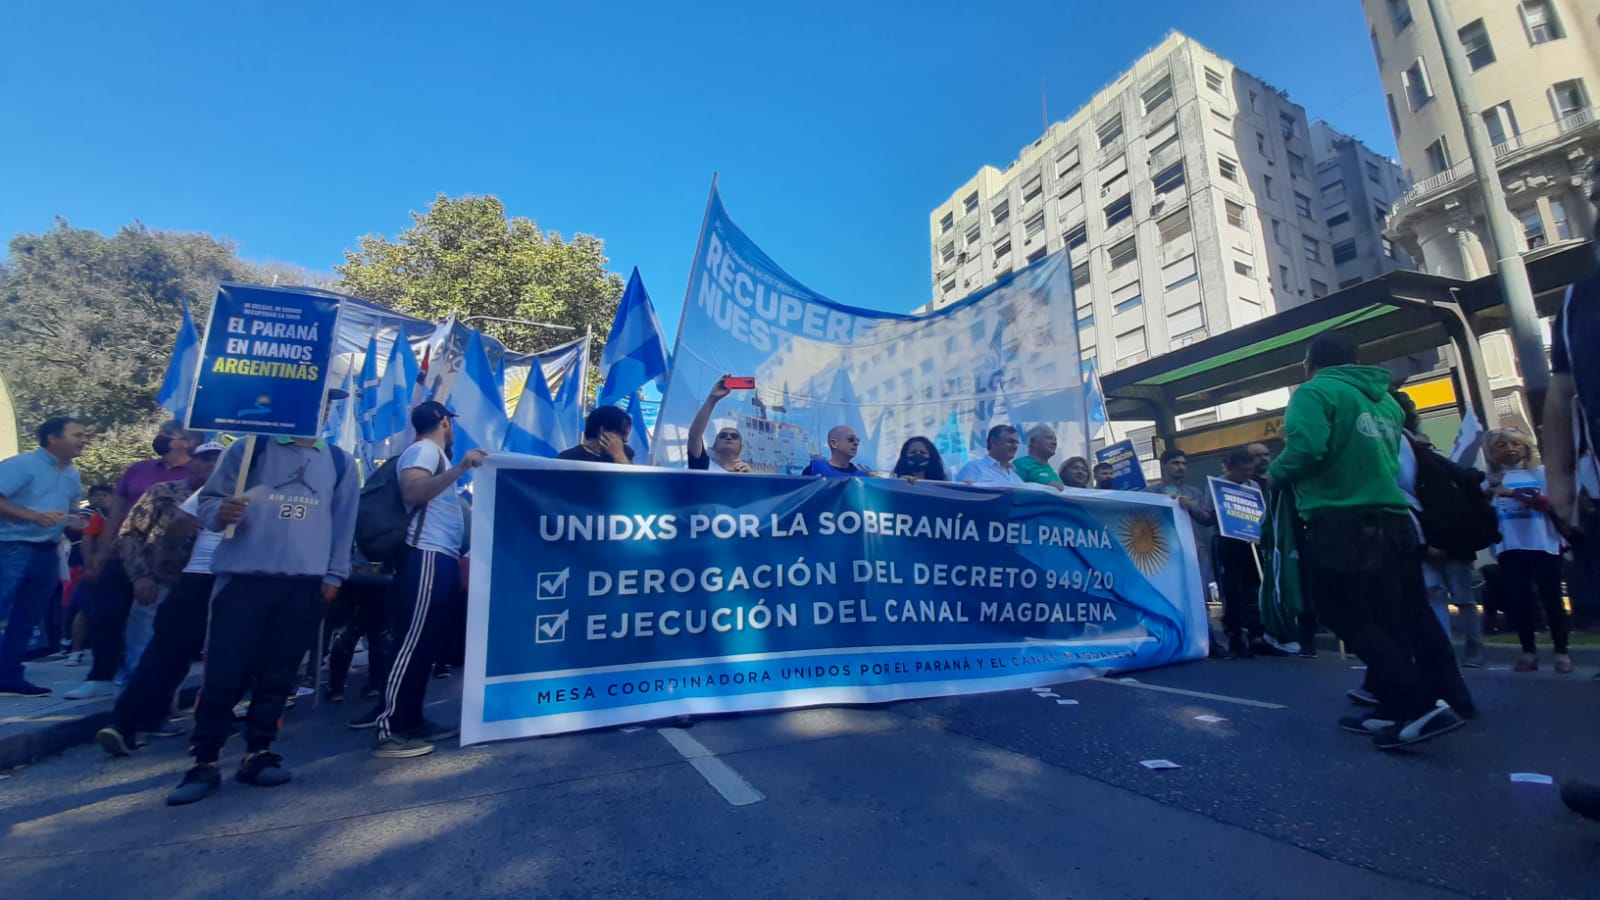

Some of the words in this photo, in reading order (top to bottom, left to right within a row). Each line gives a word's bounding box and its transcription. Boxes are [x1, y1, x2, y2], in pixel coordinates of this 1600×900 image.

[227, 317, 246, 334] EL
[251, 320, 320, 341] PARANÁ
[226, 338, 249, 355] EN
[253, 341, 313, 361] MANOS
[212, 357, 319, 381] ARGENTINAS
[269, 494, 285, 502] AIR
[288, 496, 319, 505] JORDAN
[279, 503, 307, 520] 23
[539, 514, 678, 541] UNIDXS
[690, 514, 760, 539] POR
[771, 512, 809, 538] LA
[818, 509, 980, 541] SOBERANÍA
[988, 520, 1033, 545] DEL
[1038, 525, 1113, 550] PARANÁ
[588, 556, 837, 597] DEROGACIÓN
[852, 559, 904, 584] DEL
[913, 562, 1038, 589] DECRETO
[1046, 568, 1115, 592] 949/20
[586, 598, 798, 641] EJECUCIÓN
[813, 599, 877, 625] DEL
[885, 599, 969, 623] CANAL
[979, 601, 1118, 623] MAGDALENA
[537, 686, 595, 704] MESA
[607, 669, 772, 697] COORDINADORA
[780, 664, 851, 680] UNIDOS
[916, 656, 971, 672] PARANÁ
[976, 659, 985, 670] Y
[991, 657, 1006, 669] EL
[1011, 653, 1060, 667] CANAL
